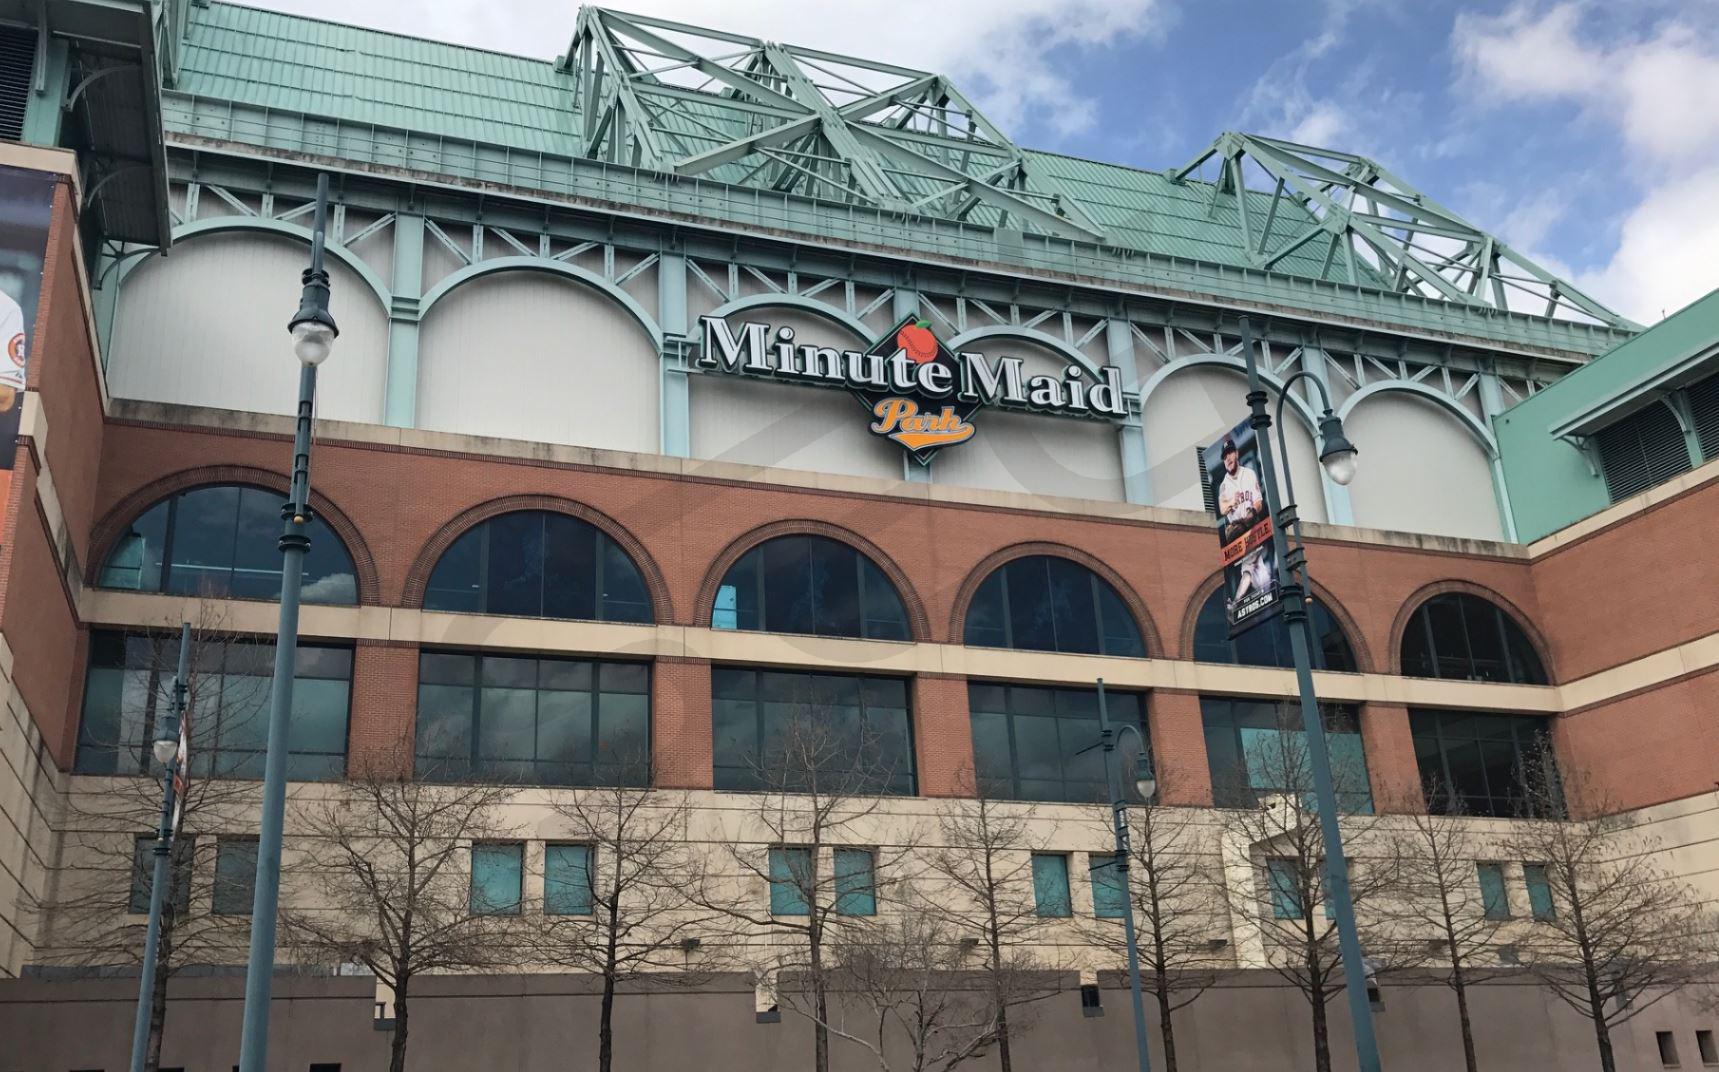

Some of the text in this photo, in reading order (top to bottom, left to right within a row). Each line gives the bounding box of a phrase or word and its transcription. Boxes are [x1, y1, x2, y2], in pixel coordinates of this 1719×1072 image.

[699, 315, 1128, 415] Minute Maid
[871, 397, 965, 435] Park
[1224, 540, 1243, 562] MORE
[1237, 592, 1273, 619] ASTROS.COM
